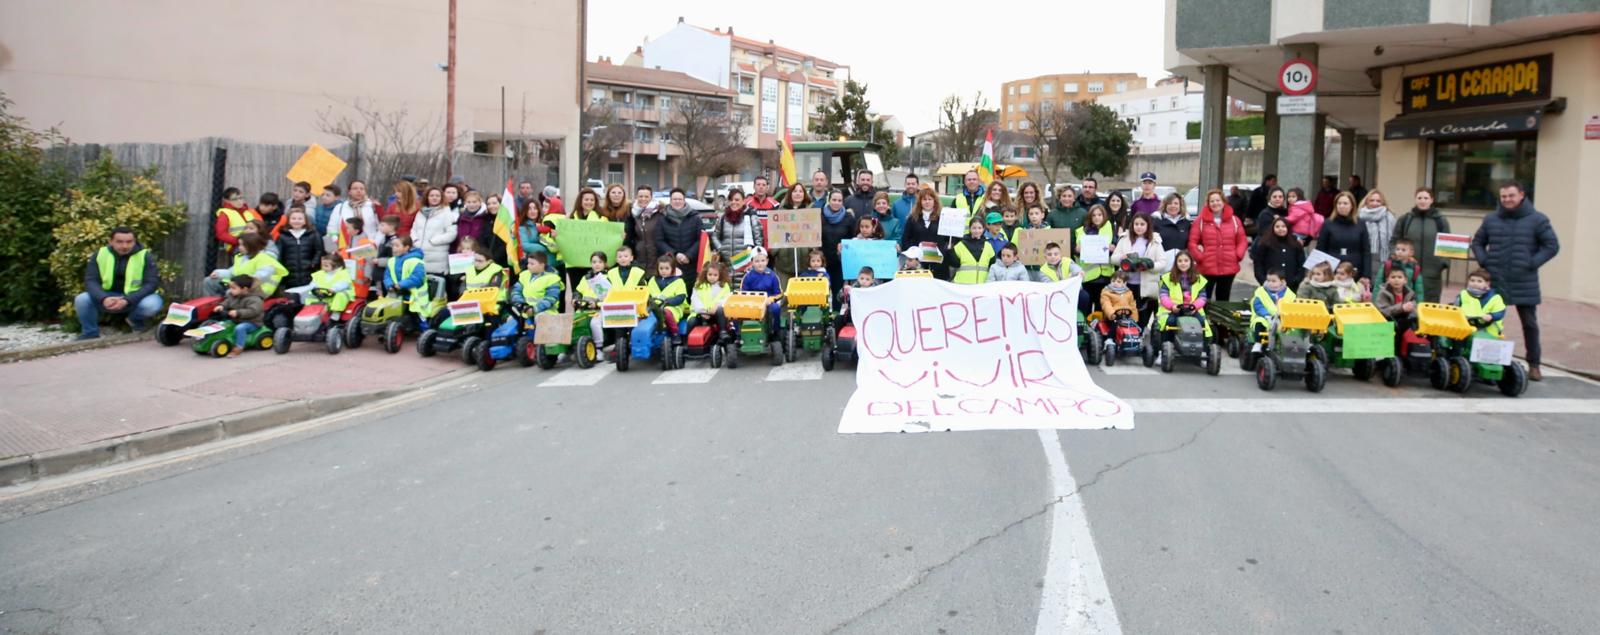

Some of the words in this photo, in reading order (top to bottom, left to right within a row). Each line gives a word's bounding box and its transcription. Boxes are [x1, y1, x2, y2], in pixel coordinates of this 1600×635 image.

[1436, 73, 1456, 102] LA
[1460, 60, 1539, 98] CERRADA
[1419, 126, 1436, 136] La
[1440, 120, 1509, 135] Cerrada
[862, 290, 1073, 362] QUEREMOS
